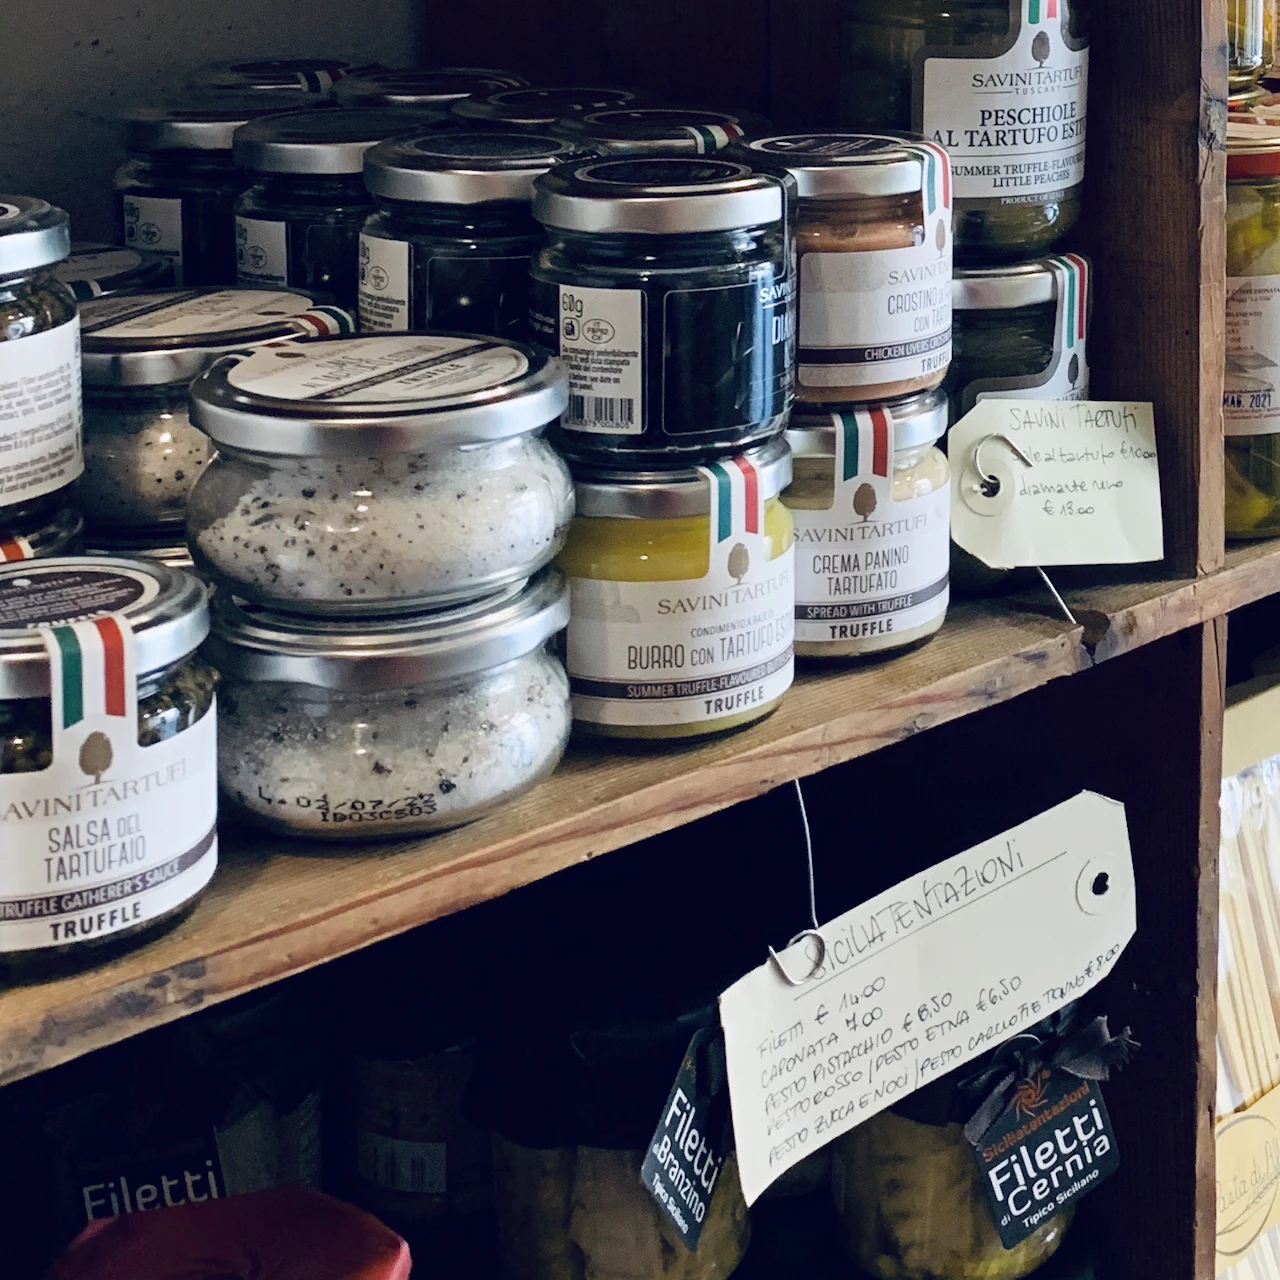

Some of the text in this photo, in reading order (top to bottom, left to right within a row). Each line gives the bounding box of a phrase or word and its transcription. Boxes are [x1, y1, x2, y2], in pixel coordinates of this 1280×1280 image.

[971, 65, 1083, 88] SAVINI TARTUFI
[1015, 85, 1062, 96] TUSCANY
[979, 100, 1077, 127] PESCHIOLE
[932, 122, 1058, 148] AL TARTUFO
[992, 168, 1071, 189] LITTLE PEACHES
[1000, 193, 1039, 205] PRODUCT
[887, 266, 936, 286] SAVINI
[562, 292, 583, 318] 60g
[887, 286, 937, 315] CROSTINO
[913, 315, 930, 333] CON
[864, 339, 929, 361] CHICKEN LIVERS
[1249, 393, 1272, 408] 2021
[1042, 499, 1055, 516] €
[792, 512, 928, 544] SAVINI TARTUFI
[813, 544, 910, 575] CREMA PANINO
[657, 569, 790, 616] SAVINI TARTUFI
[826, 569, 898, 597] TARTUFATO
[806, 594, 913, 619] SPREAD WITH TRUFFLE
[690, 612, 769, 639] CONDIMENTO BASE
[829, 618, 894, 639] TRUFFLE
[627, 623, 774, 671] BURRO CON TARTUFO
[626, 661, 767, 699] SUMMER TRUFFLE-FLAVOURED
[704, 685, 765, 715] TRUFFLE
[84, 758, 187, 808] TARTUFI
[48, 811, 142, 855] SALSA DEL
[44, 834, 146, 884] TARTUFAIO
[60, 875, 145, 911] GATHERER'S
[145, 859, 181, 889] SAUCE
[49, 902, 143, 941] TRUFFLE
[813, 1004, 830, 1026] €
[760, 1033, 839, 1090] CAPONATA
[763, 1075, 807, 1115] PESTO
[901, 1010, 915, 1035] €
[765, 1009, 970, 1137] PESTO ROSSO ETNA
[767, 976, 1086, 1167] PESTO ZUCCA TONNO
[982, 1080, 1092, 1163] Siciliatentazioni
[664, 1087, 723, 1195] Filetti
[987, 1098, 1105, 1203] Filetti
[656, 1134, 706, 1224] Branzino
[1000, 1134, 1111, 1227] di Cernia
[1250, 1157, 1266, 1187] di
[82, 1159, 220, 1222] Filetti
[651, 1172, 690, 1235] Tipico Siciliano
[1021, 1169, 1100, 1228] Tipico Siciliano
